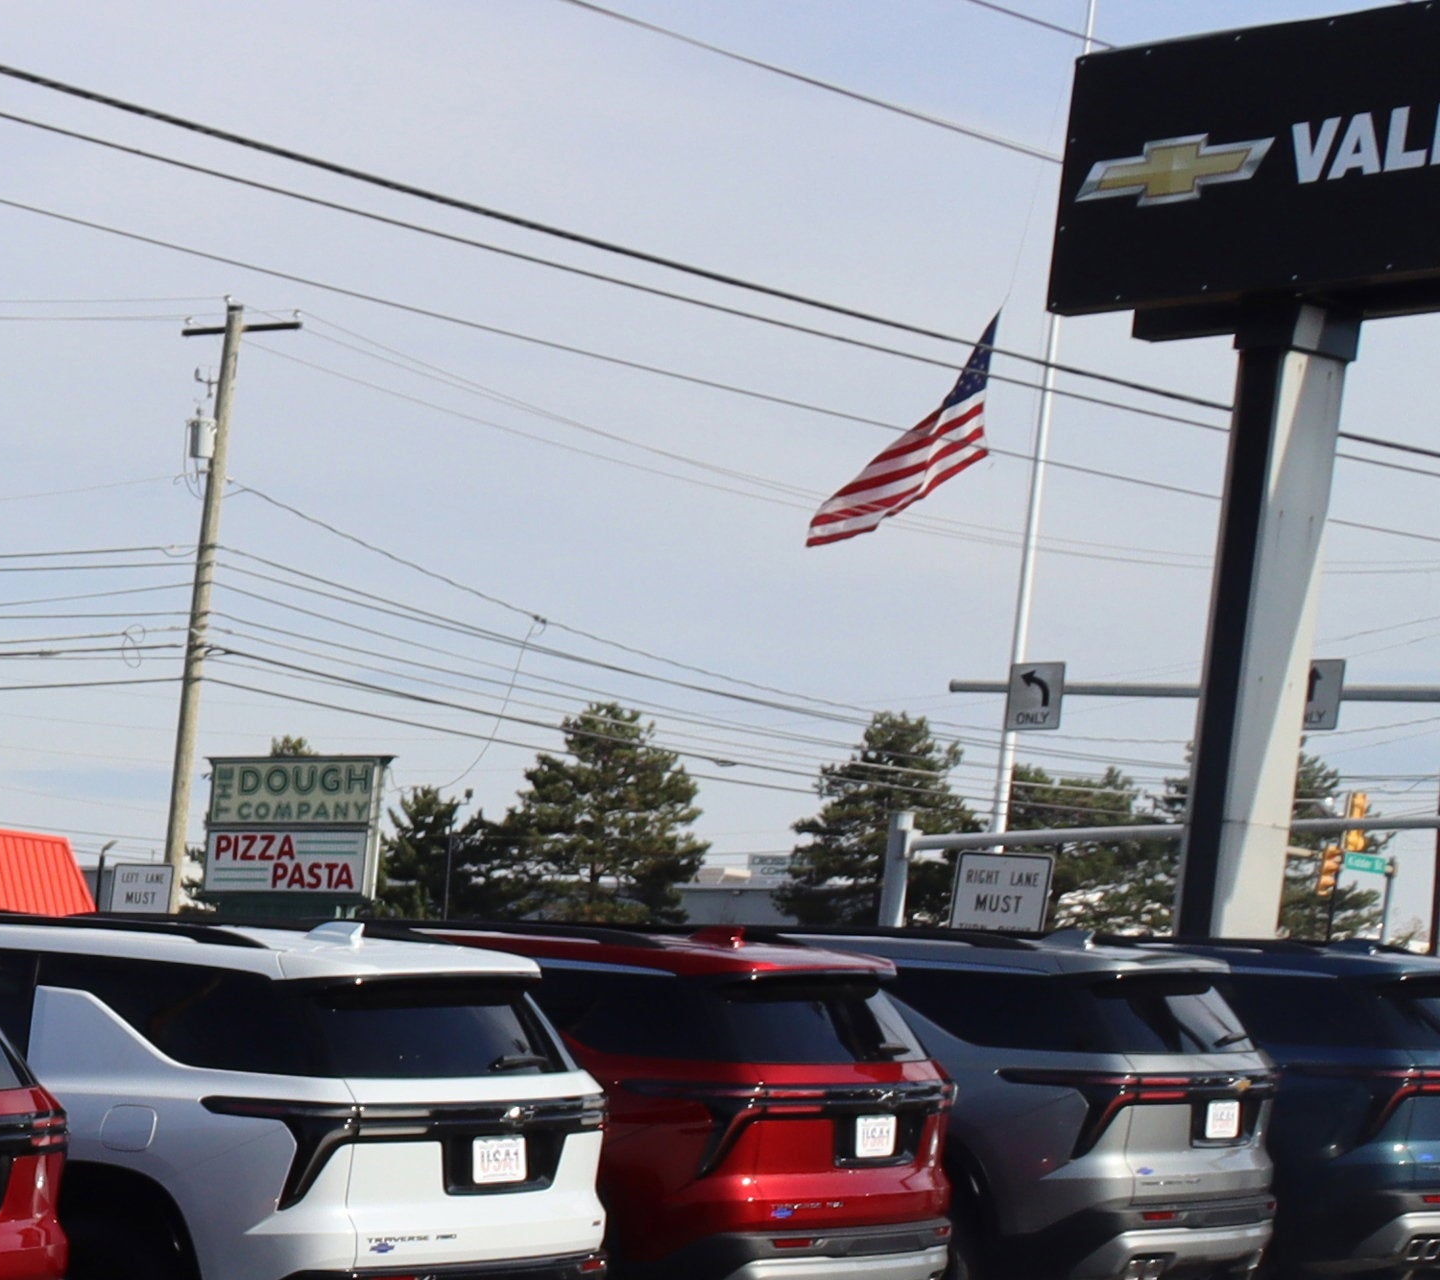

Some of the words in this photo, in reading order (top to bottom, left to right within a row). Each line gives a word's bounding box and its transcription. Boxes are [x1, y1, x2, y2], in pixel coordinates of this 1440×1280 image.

[1016, 711, 1050, 725] ONLY
[214, 766, 234, 820] THE
[238, 765, 372, 796] DOUGH
[237, 801, 370, 820] COMPANY
[215, 834, 295, 861] PIZZA
[121, 872, 140, 884] LEFT
[145, 873, 165, 885] LANE
[271, 862, 354, 890] PASTA
[966, 869, 1000, 885] RIGHT
[1010, 871, 1040, 888] LANE
[125, 891, 157, 905] MUST
[974, 894, 1023, 913] MUST
[368, 1234, 429, 1243] TRAVERSE
